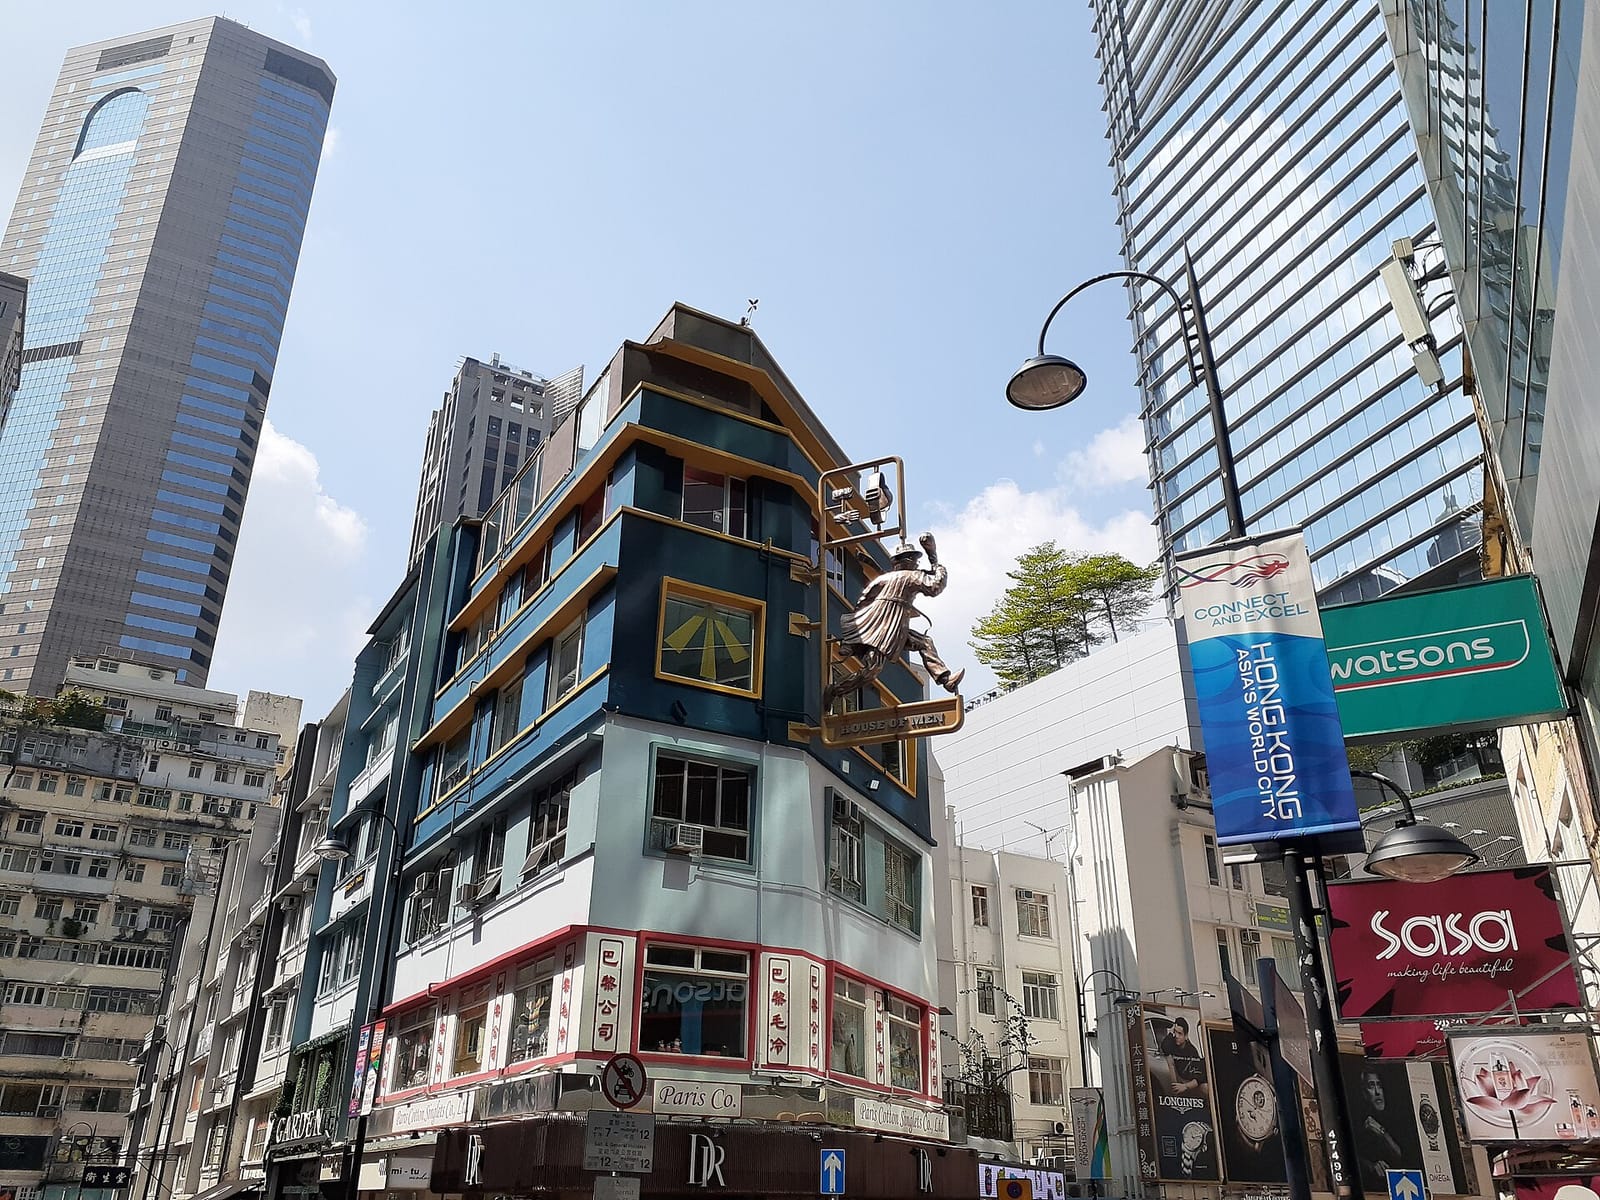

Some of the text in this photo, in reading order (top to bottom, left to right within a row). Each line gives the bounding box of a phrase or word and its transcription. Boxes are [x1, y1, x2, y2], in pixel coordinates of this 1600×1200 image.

[1194, 591, 1289, 620] CONNECT
[1211, 603, 1309, 628] AND EXCEL
[1330, 636, 1495, 680] watsons
[840, 713, 946, 736] HOUSE OF MEN
[1236, 648, 1277, 820] ASIA'S WORLD CITY
[1250, 641, 1303, 820] HONG KONG
[1387, 958, 1514, 983] making life beautiful
[598, 950, 619, 1042] 巴黎公司
[770, 968, 787, 1056] 巴黎毛冷
[658, 1085, 737, 1111] Paris Co.
[1158, 1095, 1205, 1110] LONGINES
[275, 1108, 324, 1144] GARDEN
[859, 1102, 878, 1121] Paris
[878, 1106, 899, 1125] Cotton
[900, 1110, 922, 1133] Singlets
[605, 1127, 612, 1137] 7
[640, 1129, 650, 1140] 12
[600, 1156, 611, 1167] 12
[640, 1158, 650, 1169] 12
[1328, 1129, 1343, 1182] 47496
[1429, 1173, 1451, 1182] OMEGA
